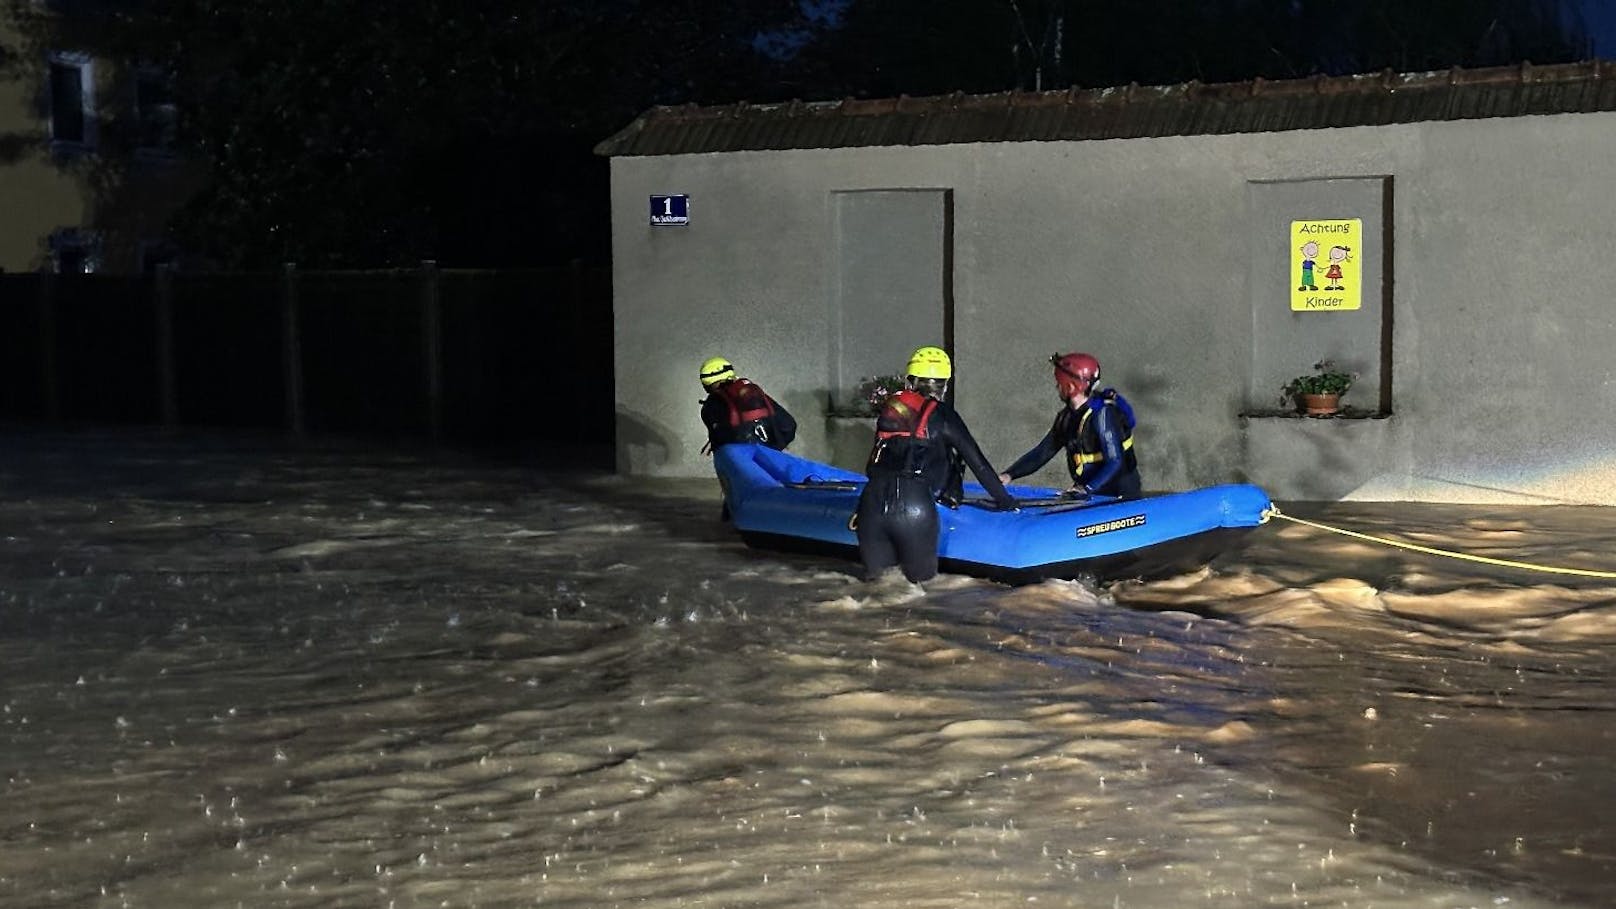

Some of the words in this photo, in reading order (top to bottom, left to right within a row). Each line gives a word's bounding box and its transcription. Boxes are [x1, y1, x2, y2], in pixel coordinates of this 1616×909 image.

[664, 198, 671, 214] 1
[1300, 223, 1350, 234] Achtung
[1306, 297, 1343, 308] Kinder
[1110, 518, 1135, 530] BOOTE
